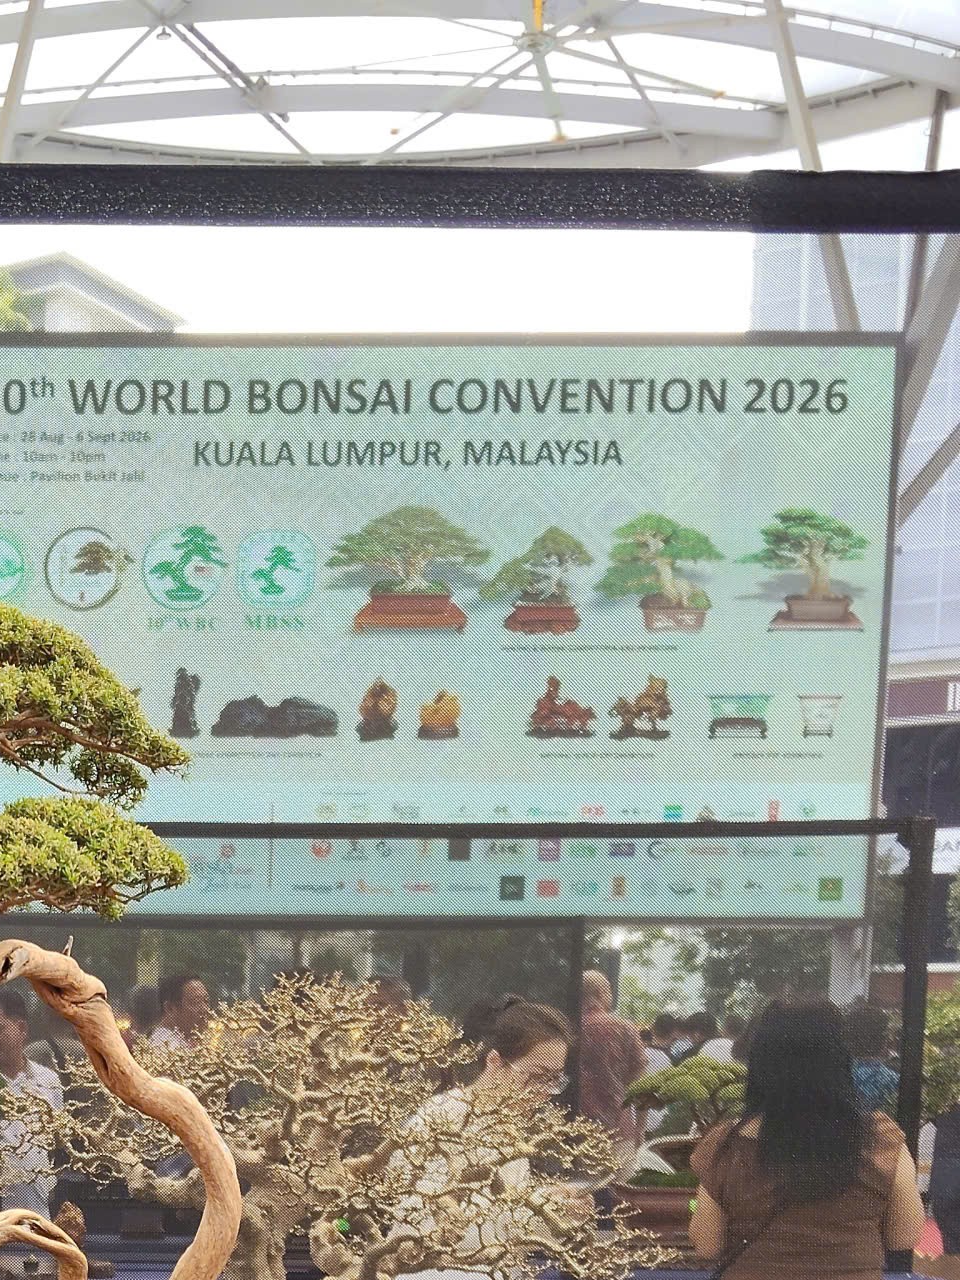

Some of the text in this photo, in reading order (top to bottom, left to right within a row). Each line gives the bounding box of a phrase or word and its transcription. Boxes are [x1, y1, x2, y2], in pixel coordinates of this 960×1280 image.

[67, 378, 232, 416] WORLD
[247, 378, 412, 416] BONSAI
[428, 377, 728, 416] CONVENTION
[743, 377, 849, 415] 2026
[20, 431, 37, 443] 28
[40, 431, 65, 446] Aug
[76, 431, 85, 443] 6
[88, 431, 117, 446] Sept
[119, 431, 152, 443] 2026
[22, 450, 59, 463] 10am
[69, 450, 107, 466] 10pm
[193, 440, 624, 472] KUALA LUMPUR, MALAYSIA
[30, 470, 81, 483] Pavilion
[84, 470, 118, 483] Bukit
[120, 470, 146, 483] Jalil
[176, 617, 217, 631] WBC
[244, 614, 305, 631] MBSS
